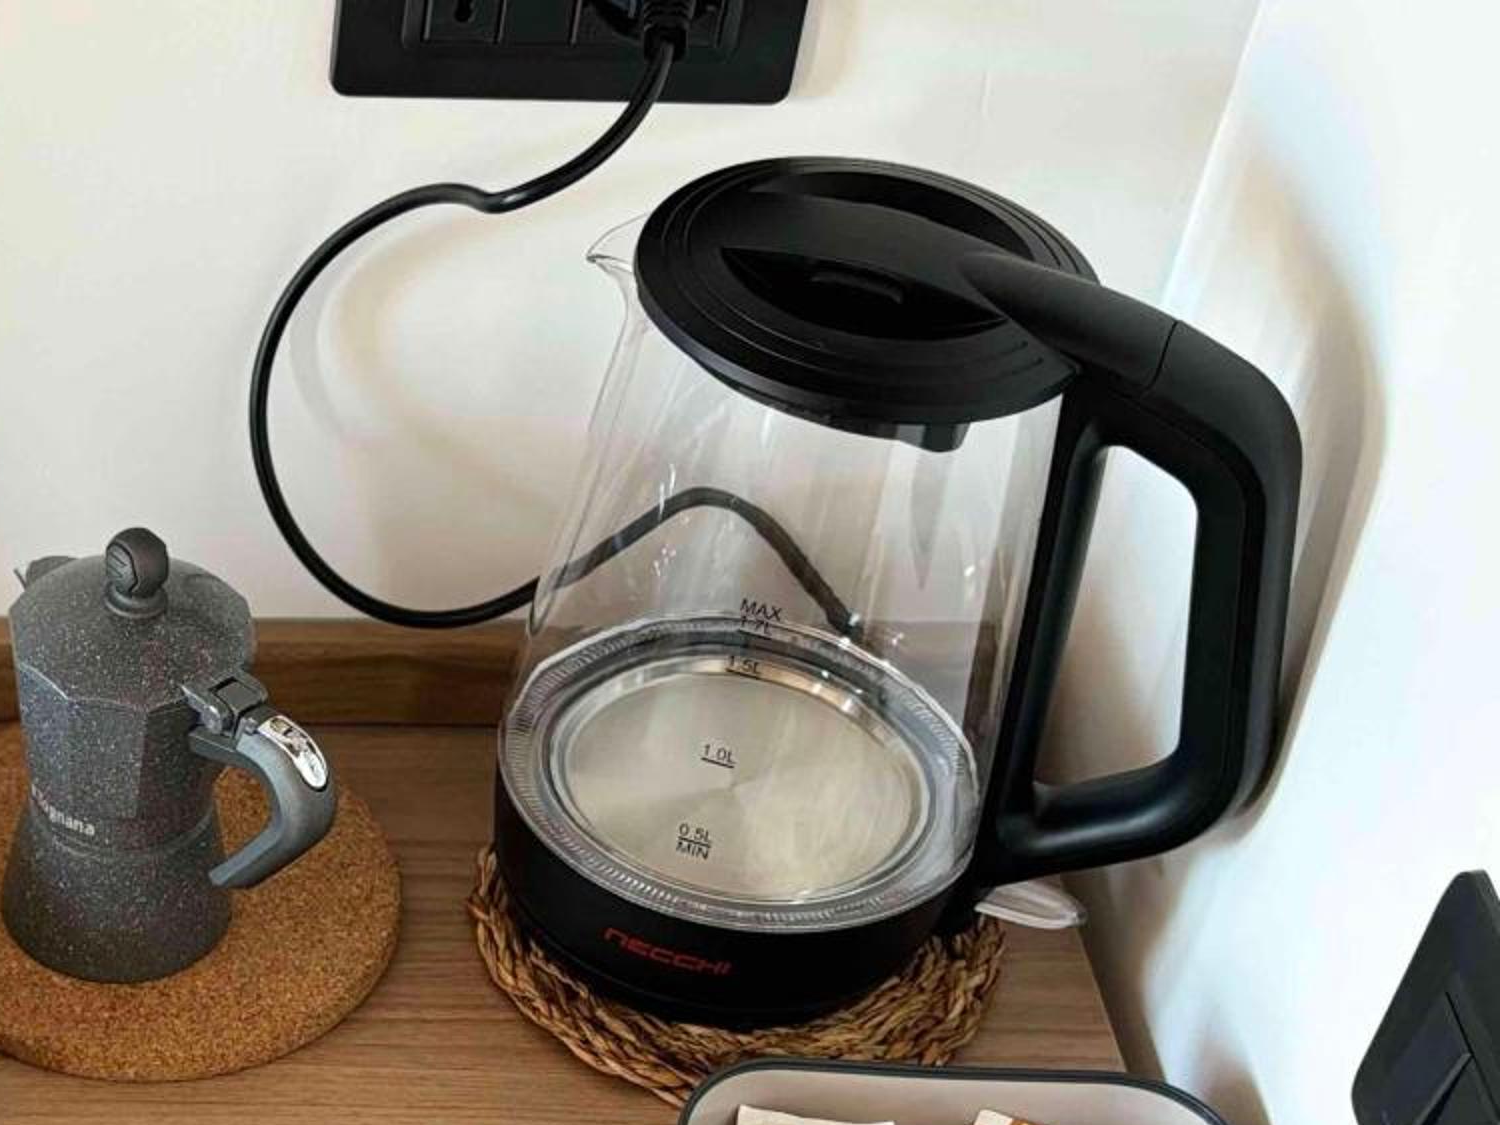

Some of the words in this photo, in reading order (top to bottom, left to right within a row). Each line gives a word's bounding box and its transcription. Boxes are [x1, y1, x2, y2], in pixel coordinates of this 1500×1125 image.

[740, 599, 781, 621] MAX
[702, 743, 736, 764] 1.0L
[678, 823, 712, 843] 0.5L
[676, 841, 710, 861] MIN
